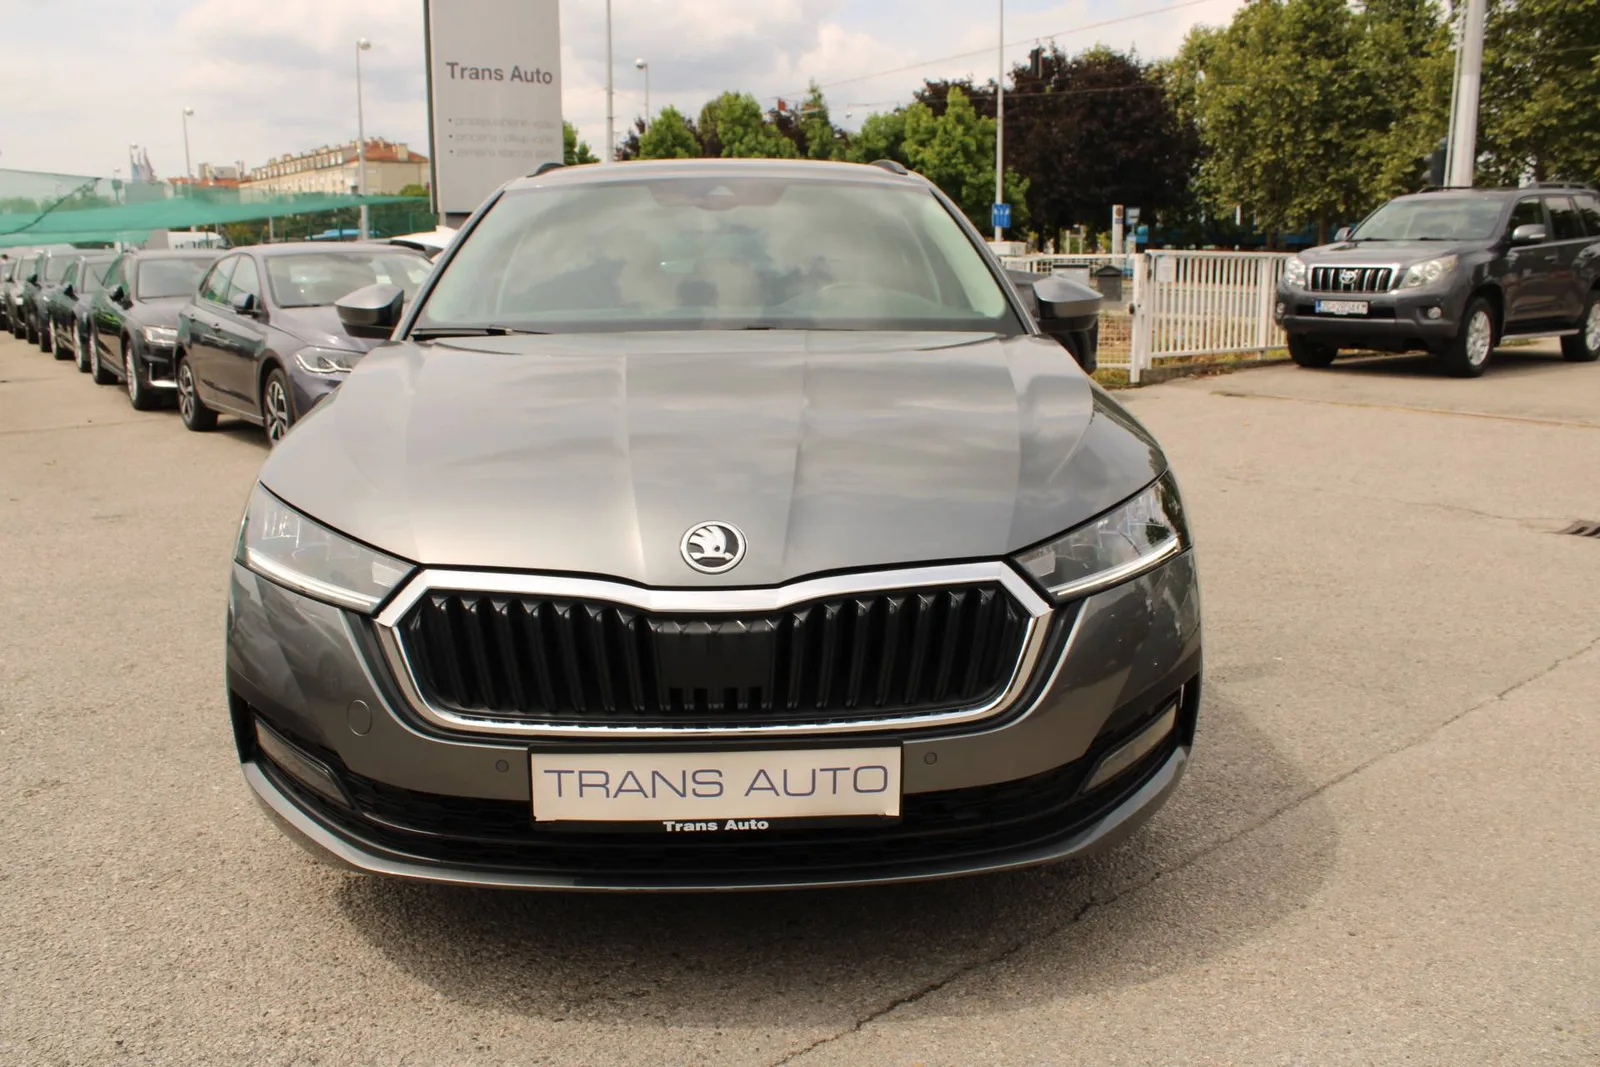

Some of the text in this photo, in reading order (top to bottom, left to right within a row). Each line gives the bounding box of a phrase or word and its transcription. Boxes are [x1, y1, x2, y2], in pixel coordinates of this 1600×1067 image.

[446, 61, 553, 85] Trans Auto
[543, 765, 888, 799] TRANS AUTO
[662, 819, 769, 832] Trans Auto
